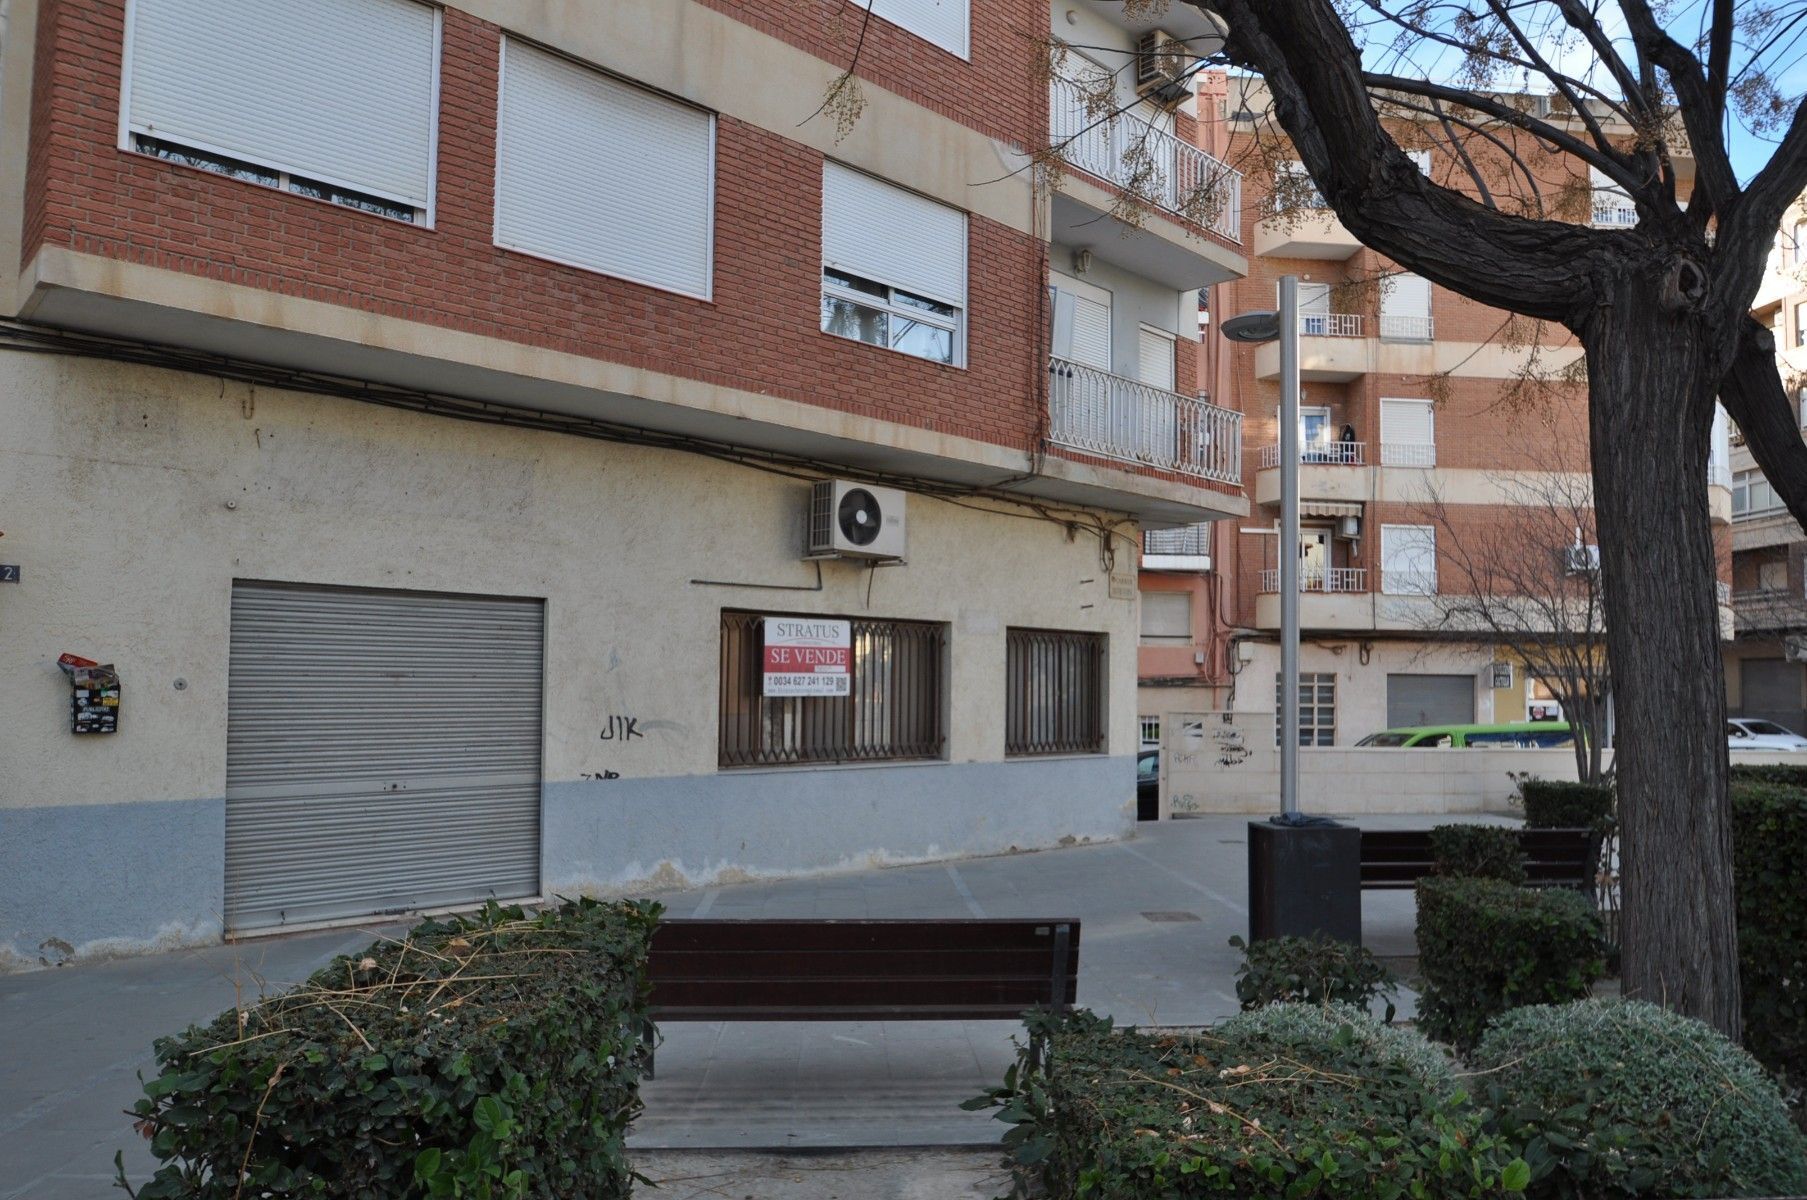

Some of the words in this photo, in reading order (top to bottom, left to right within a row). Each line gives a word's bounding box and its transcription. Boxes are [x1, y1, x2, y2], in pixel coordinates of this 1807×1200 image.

[4, 566, 13, 580] 2
[776, 623, 840, 639] STRATUS
[771, 648, 790, 664] SE
[794, 649, 846, 665] VENDE
[773, 676, 792, 686] 0034
[793, 676, 806, 686] 627
[822, 677, 834, 686] 129
